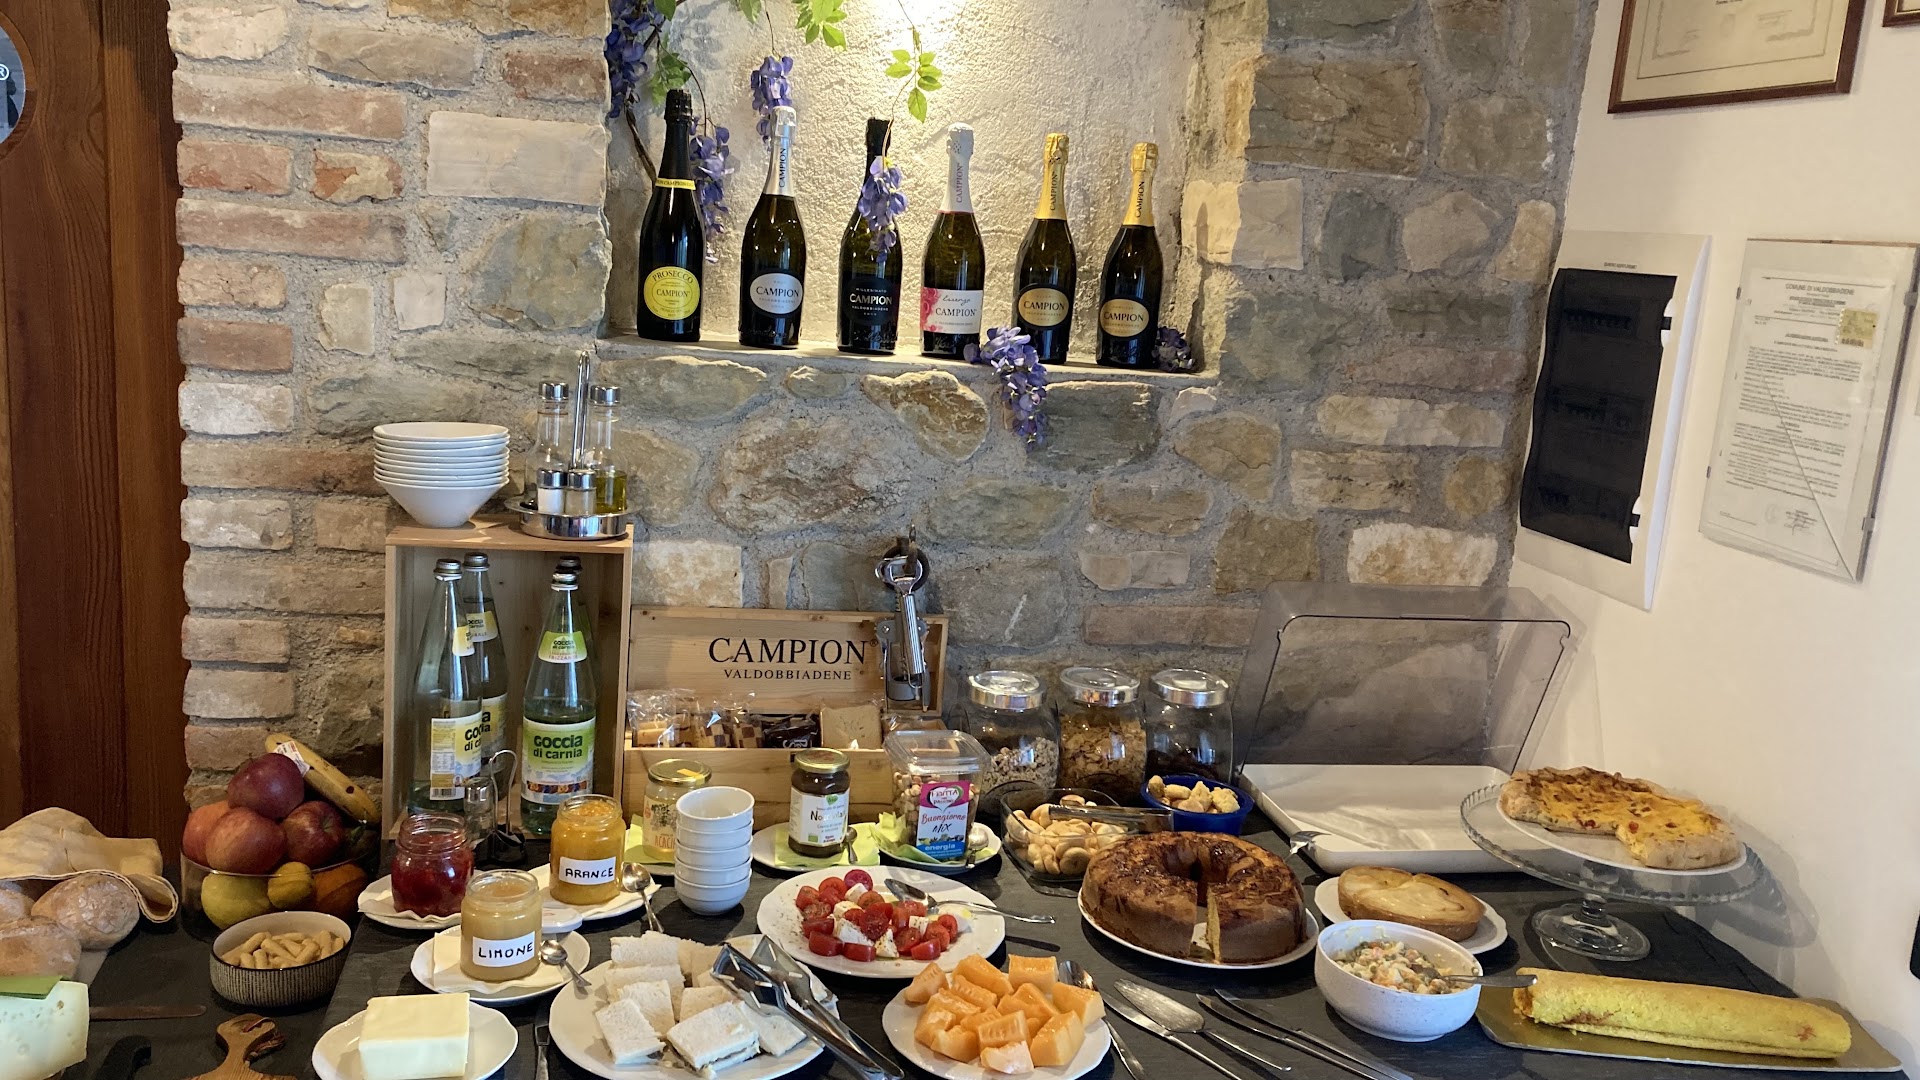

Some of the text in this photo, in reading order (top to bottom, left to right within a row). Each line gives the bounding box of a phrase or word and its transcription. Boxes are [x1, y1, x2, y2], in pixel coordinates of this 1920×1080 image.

[778, 147, 787, 188] CAMPION
[652, 270, 694, 284] PROSECCO
[656, 288, 688, 298] CAMPION
[755, 286, 800, 298] CAMPION
[849, 293, 893, 305] CAMPION
[935, 307, 977, 317] CAMPION
[1023, 301, 1065, 311] CAMPION
[1103, 311, 1144, 322] CAMPION
[723, 669, 852, 681] VALDOBBIADENE
[533, 747, 583, 759] di carnia
[921, 812, 966, 824] Buongiorno
[924, 843, 956, 851] energia
[565, 867, 614, 879] ARANCE
[478, 941, 533, 959] LIMONE
